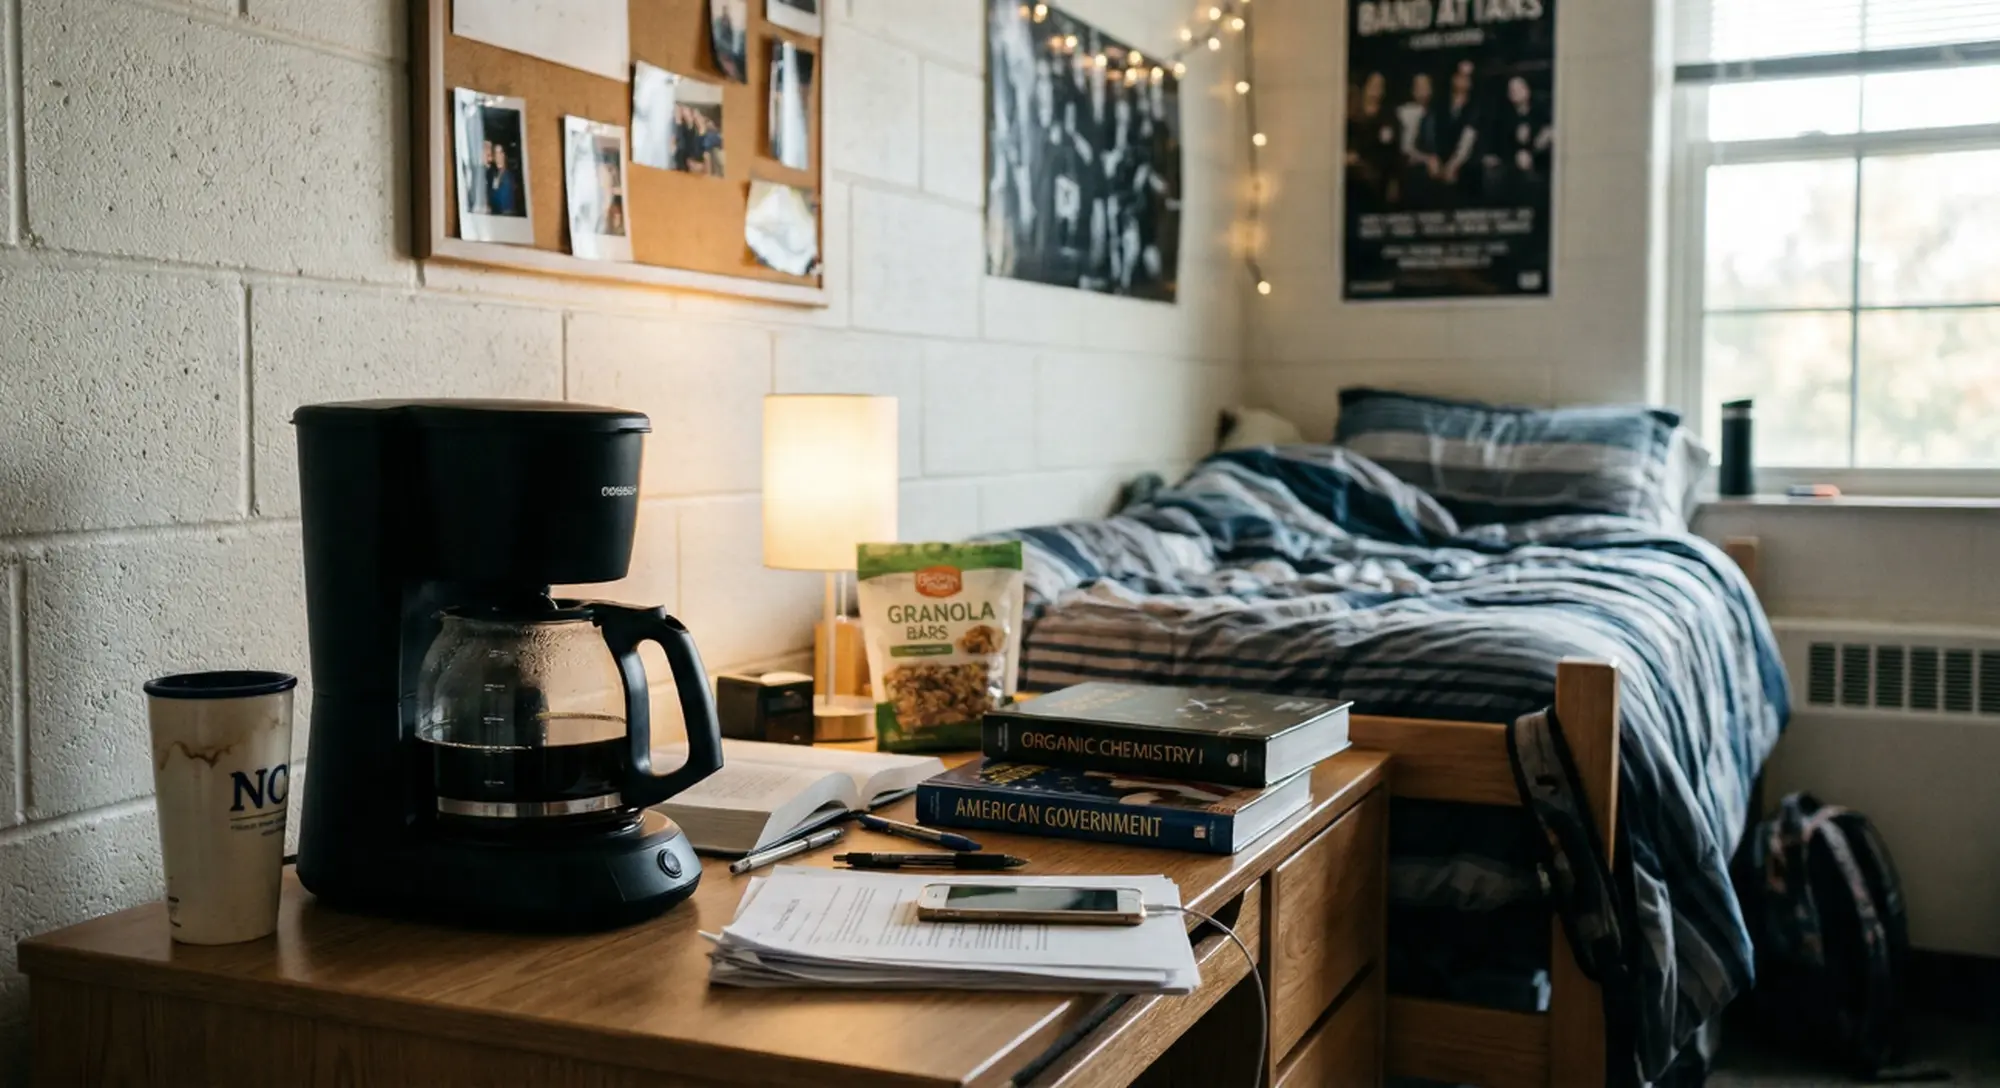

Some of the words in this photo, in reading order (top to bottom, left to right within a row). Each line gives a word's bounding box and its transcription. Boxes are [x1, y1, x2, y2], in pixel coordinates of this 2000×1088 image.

[887, 601, 996, 624] GRANOLA
[906, 625, 949, 641] BARS
[1021, 731, 1096, 755] ORGANIC
[1099, 739, 1195, 764] CHEMISTRY
[955, 796, 1040, 825] AMERICAN
[1045, 806, 1163, 838] GOVERNMENT
